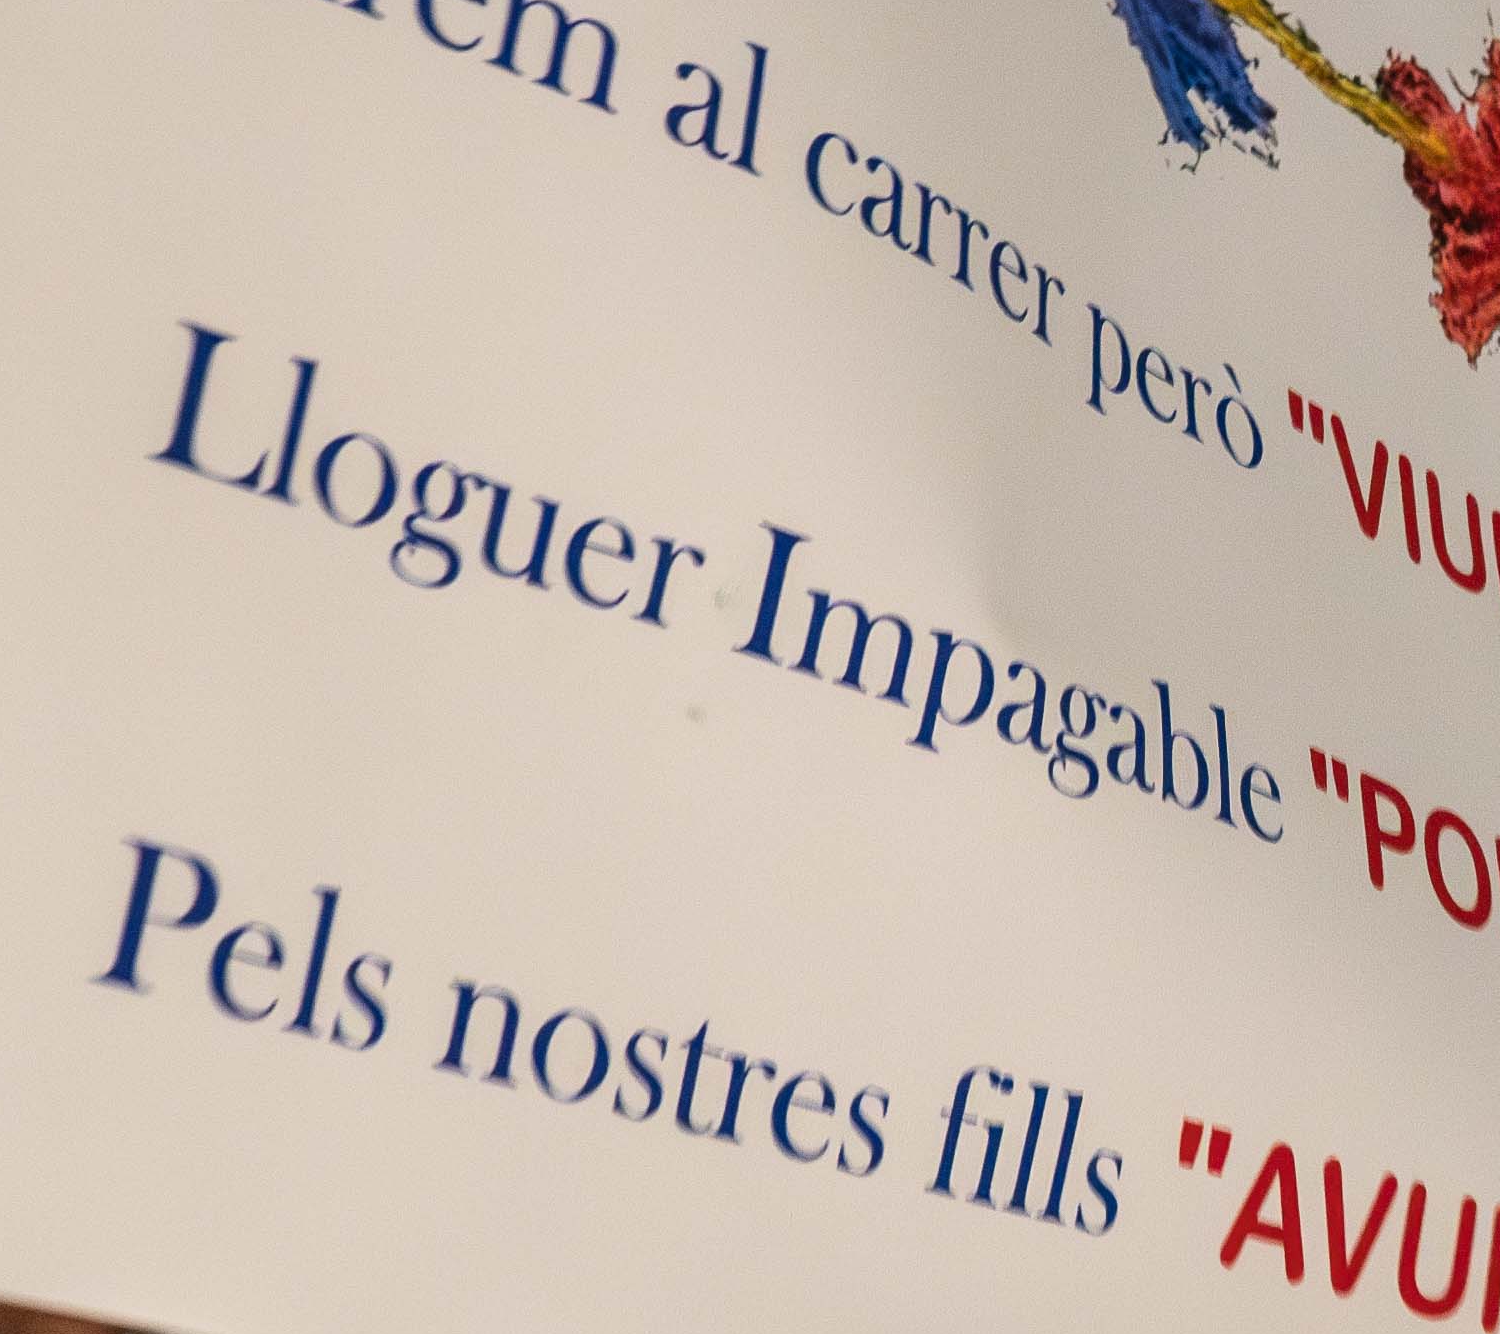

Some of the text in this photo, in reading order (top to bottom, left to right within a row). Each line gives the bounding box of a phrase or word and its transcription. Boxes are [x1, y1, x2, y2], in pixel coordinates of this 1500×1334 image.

[663, 41, 770, 177] al
[803, 131, 1068, 349] carrer
[1084, 301, 1266, 471] però
[148, 320, 706, 627] Lloguer
[731, 523, 1285, 845] Impagable
[88, 835, 394, 1052] Pels
[434, 976, 889, 1177] nostres
[923, 1065, 1124, 1236] fills
